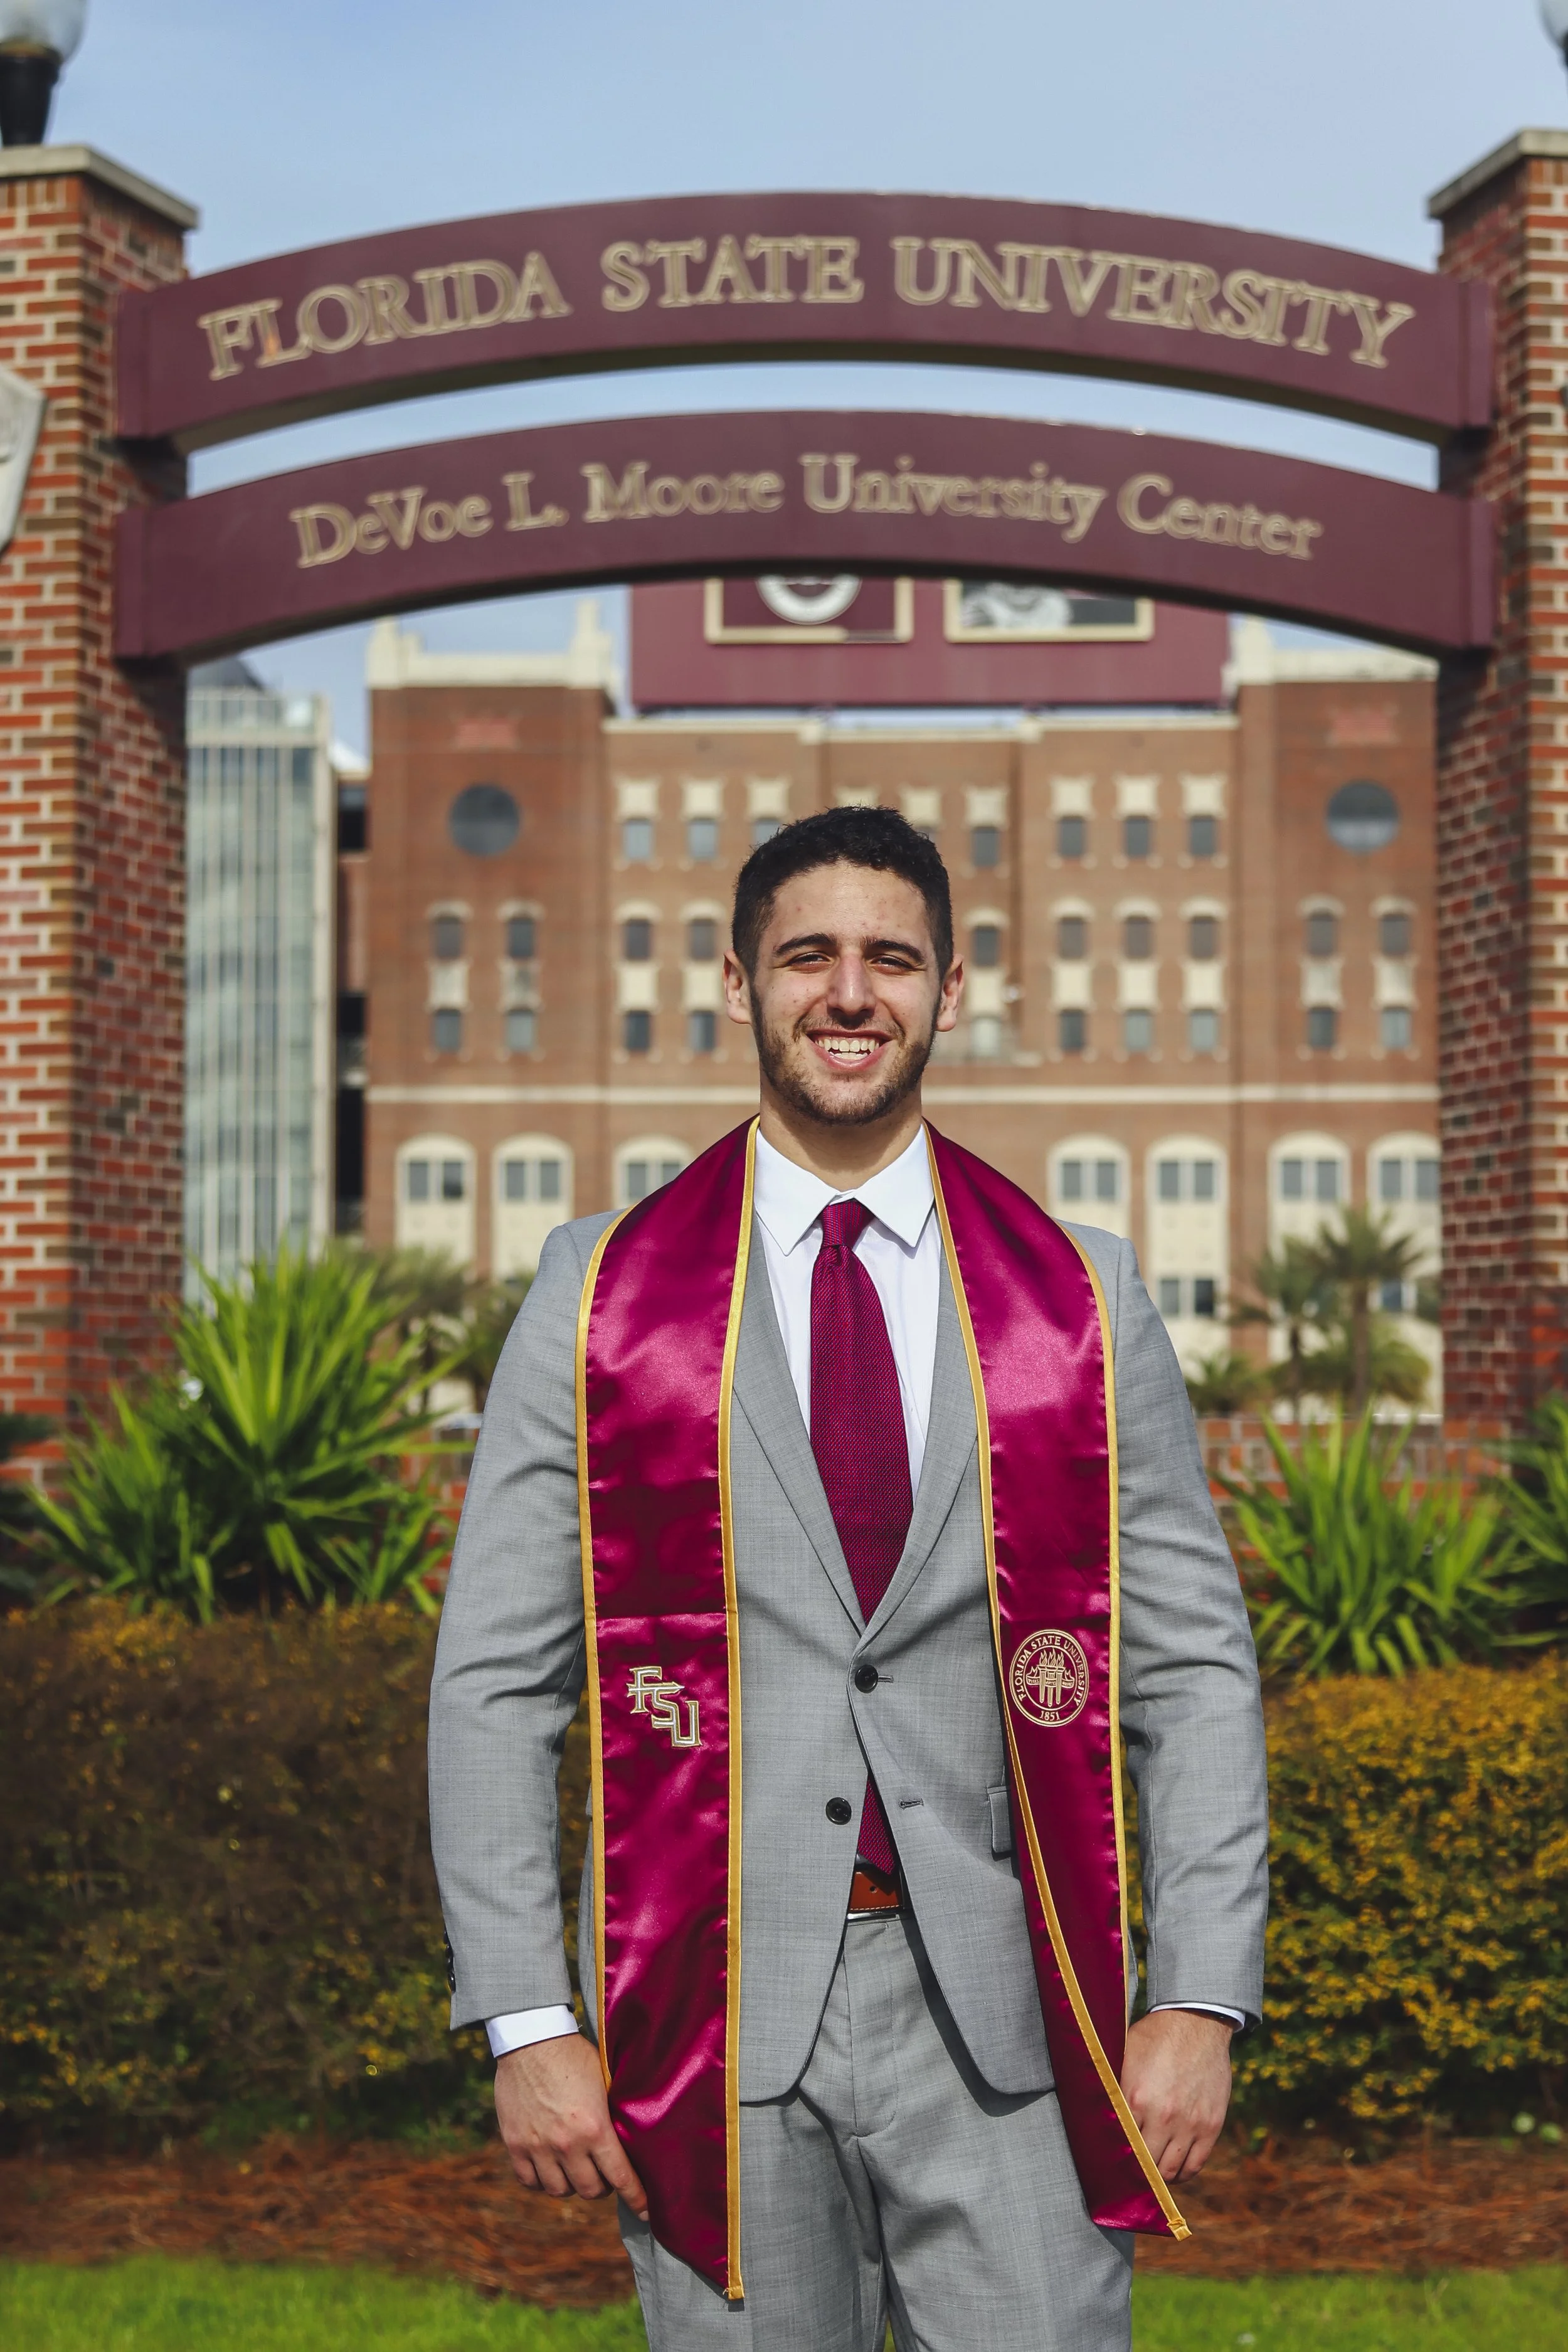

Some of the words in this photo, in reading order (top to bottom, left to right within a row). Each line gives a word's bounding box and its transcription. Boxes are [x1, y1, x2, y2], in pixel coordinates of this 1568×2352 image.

[198, 250, 572, 380] FLORIDA
[600, 235, 864, 312] STATE
[889, 235, 1415, 369] UNIVERSITY
[289, 485, 493, 568] DeVoe
[501, 471, 569, 531] L.
[580, 462, 785, 524] Moore
[798, 452, 1108, 544] University
[1117, 472, 1323, 561] Center
[626, 1666, 703, 1747] FSU
[1015, 1649, 1032, 1702] FLORIDA
[1030, 1635, 1061, 1650] STATE
[1064, 1640, 1085, 1707] UNIVERSITY
[1039, 1710, 1061, 1722] 1851
